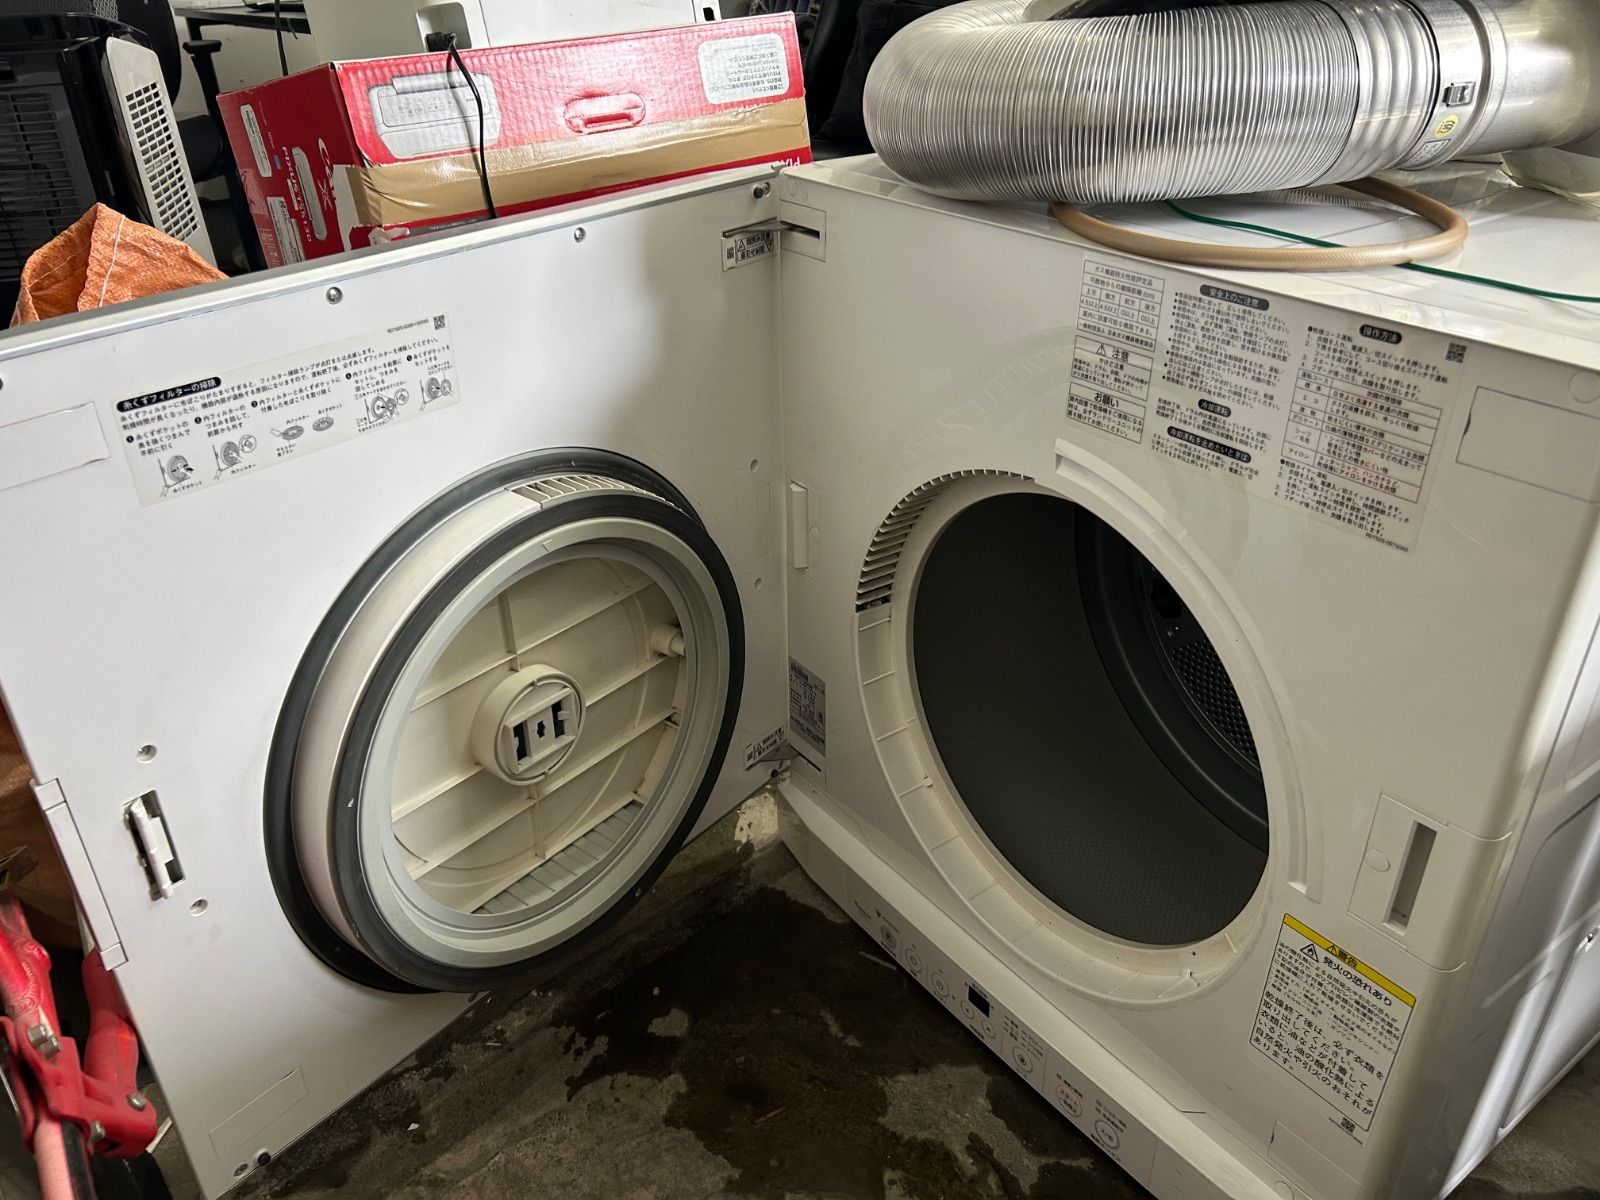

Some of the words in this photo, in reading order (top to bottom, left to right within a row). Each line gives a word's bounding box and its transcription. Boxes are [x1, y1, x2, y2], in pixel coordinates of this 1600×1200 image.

[1208, 286, 1260, 310] 安全上のご注意
[1361, 323, 1400, 345] 操作方法
[1111, 347, 1129, 363] 注意
[121, 377, 217, 411] 糸くずフィルターの掃除
[1094, 391, 1119, 408] お願い
[1200, 399, 1228, 416] 冷却運転
[1169, 426, 1247, 462] 冷却運転を止めたいときは
[1337, 950, 1357, 968] 警告
[1322, 955, 1393, 1008] 発火の恐れあり
[1253, 1033, 1294, 1071] あります。
[1259, 1006, 1368, 1093] 衣類に油などが付着して
[1261, 998, 1356, 1073] 取り出してください。
[1264, 988, 1385, 1082] 乾燥終了後は、必ず衣類を
[1255, 1025, 1372, 1118] 自然発火や引火のおそれが
[1258, 1015, 1374, 1109] いると、油の酸化熱による
